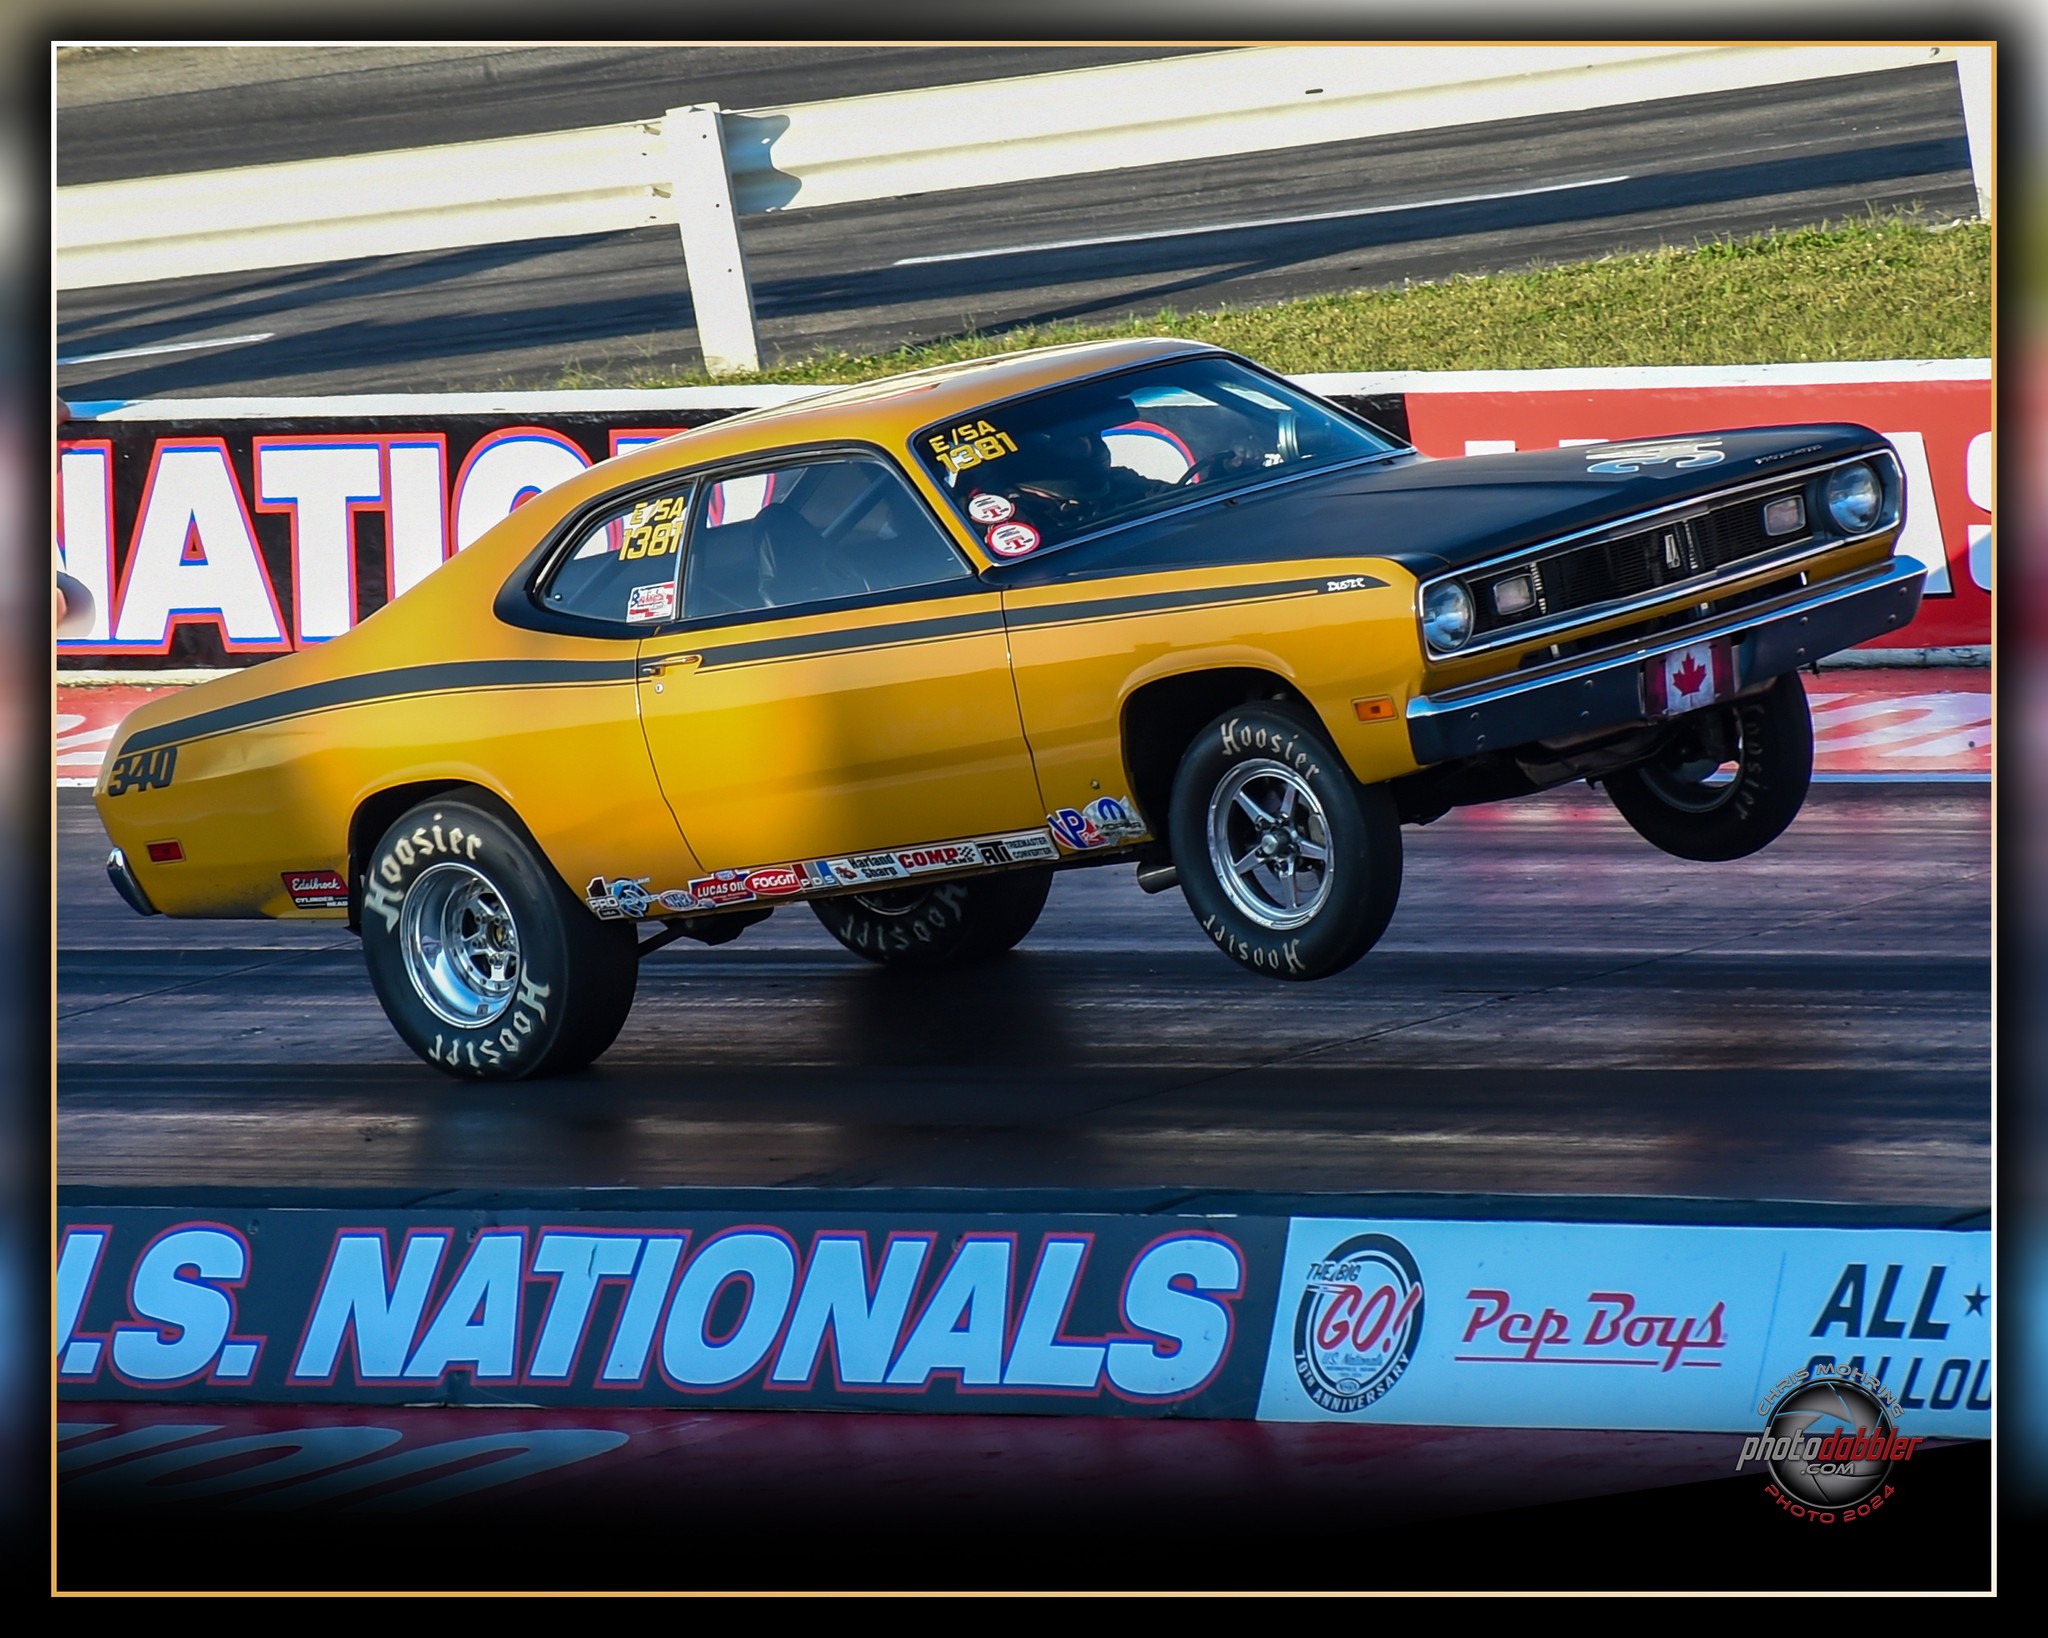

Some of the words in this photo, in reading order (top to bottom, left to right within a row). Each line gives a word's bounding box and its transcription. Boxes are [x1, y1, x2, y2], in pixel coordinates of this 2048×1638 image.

[936, 431, 1018, 474] 1381
[619, 520, 684, 560] 1381
[108, 747, 177, 797] 340
[1220, 718, 1320, 779] Hoosier
[1047, 809, 1087, 849] VP
[365, 813, 482, 933] Hoosier
[850, 853, 895, 869] Harland
[861, 866, 898, 879] Sharp
[898, 847, 959, 868] COMP
[292, 878, 341, 891] Edelbrock
[588, 898, 619, 910] PRO
[697, 883, 729, 898] LUCAS
[1203, 914, 1306, 974] Hoosier
[429, 961, 550, 1077] Hoosier
[286, 1224, 1245, 1397] NATIONALS
[1312, 1283, 1422, 1354] GO!
[1809, 1264, 1950, 1340] ALL
[1462, 1289, 1571, 1360] Pep
[1583, 1293, 1726, 1373] Boys
[1313, 1353, 1410, 1411] ANNIVERSARY
